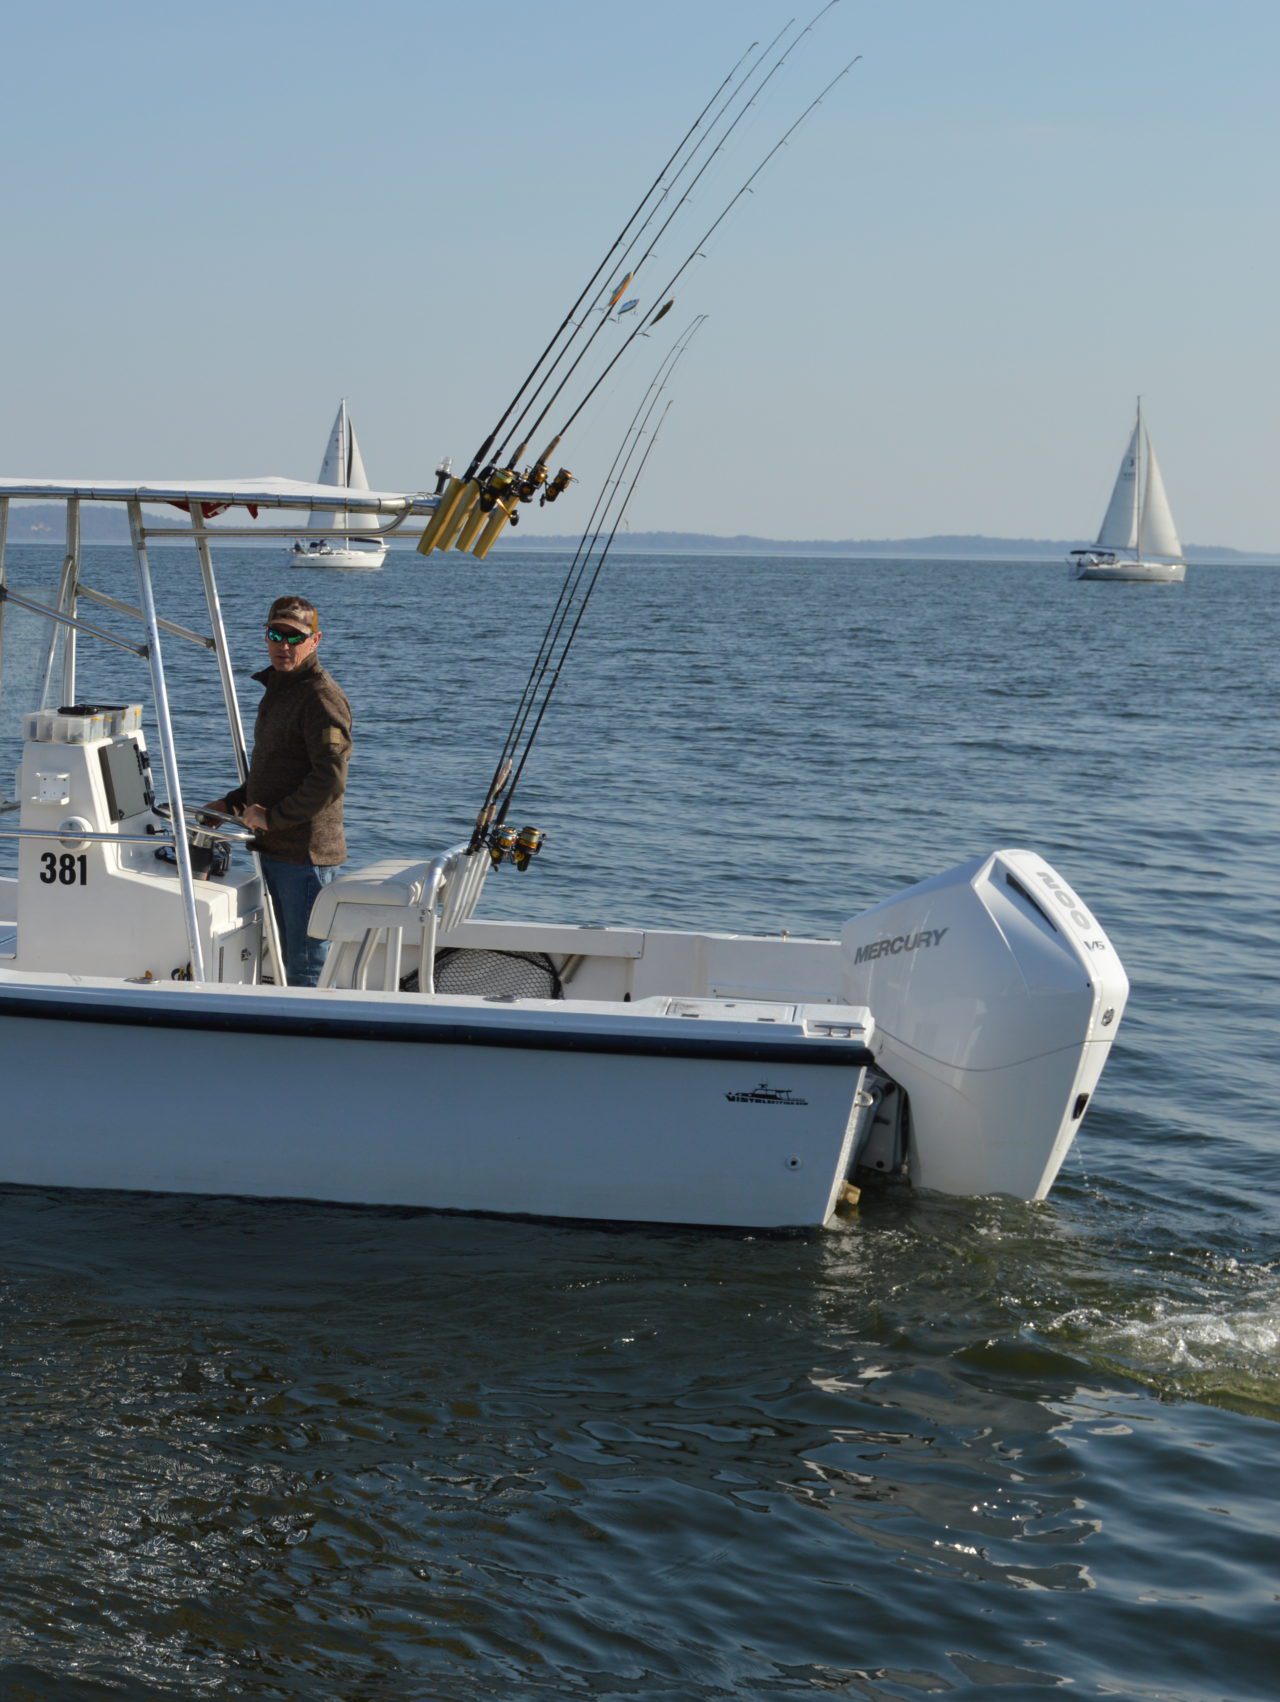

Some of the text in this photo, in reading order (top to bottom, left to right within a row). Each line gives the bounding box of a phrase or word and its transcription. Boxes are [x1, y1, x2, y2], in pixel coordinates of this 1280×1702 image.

[39, 851, 87, 886] 381
[1036, 871, 1091, 930] 200
[853, 927, 950, 965] MERCURY
